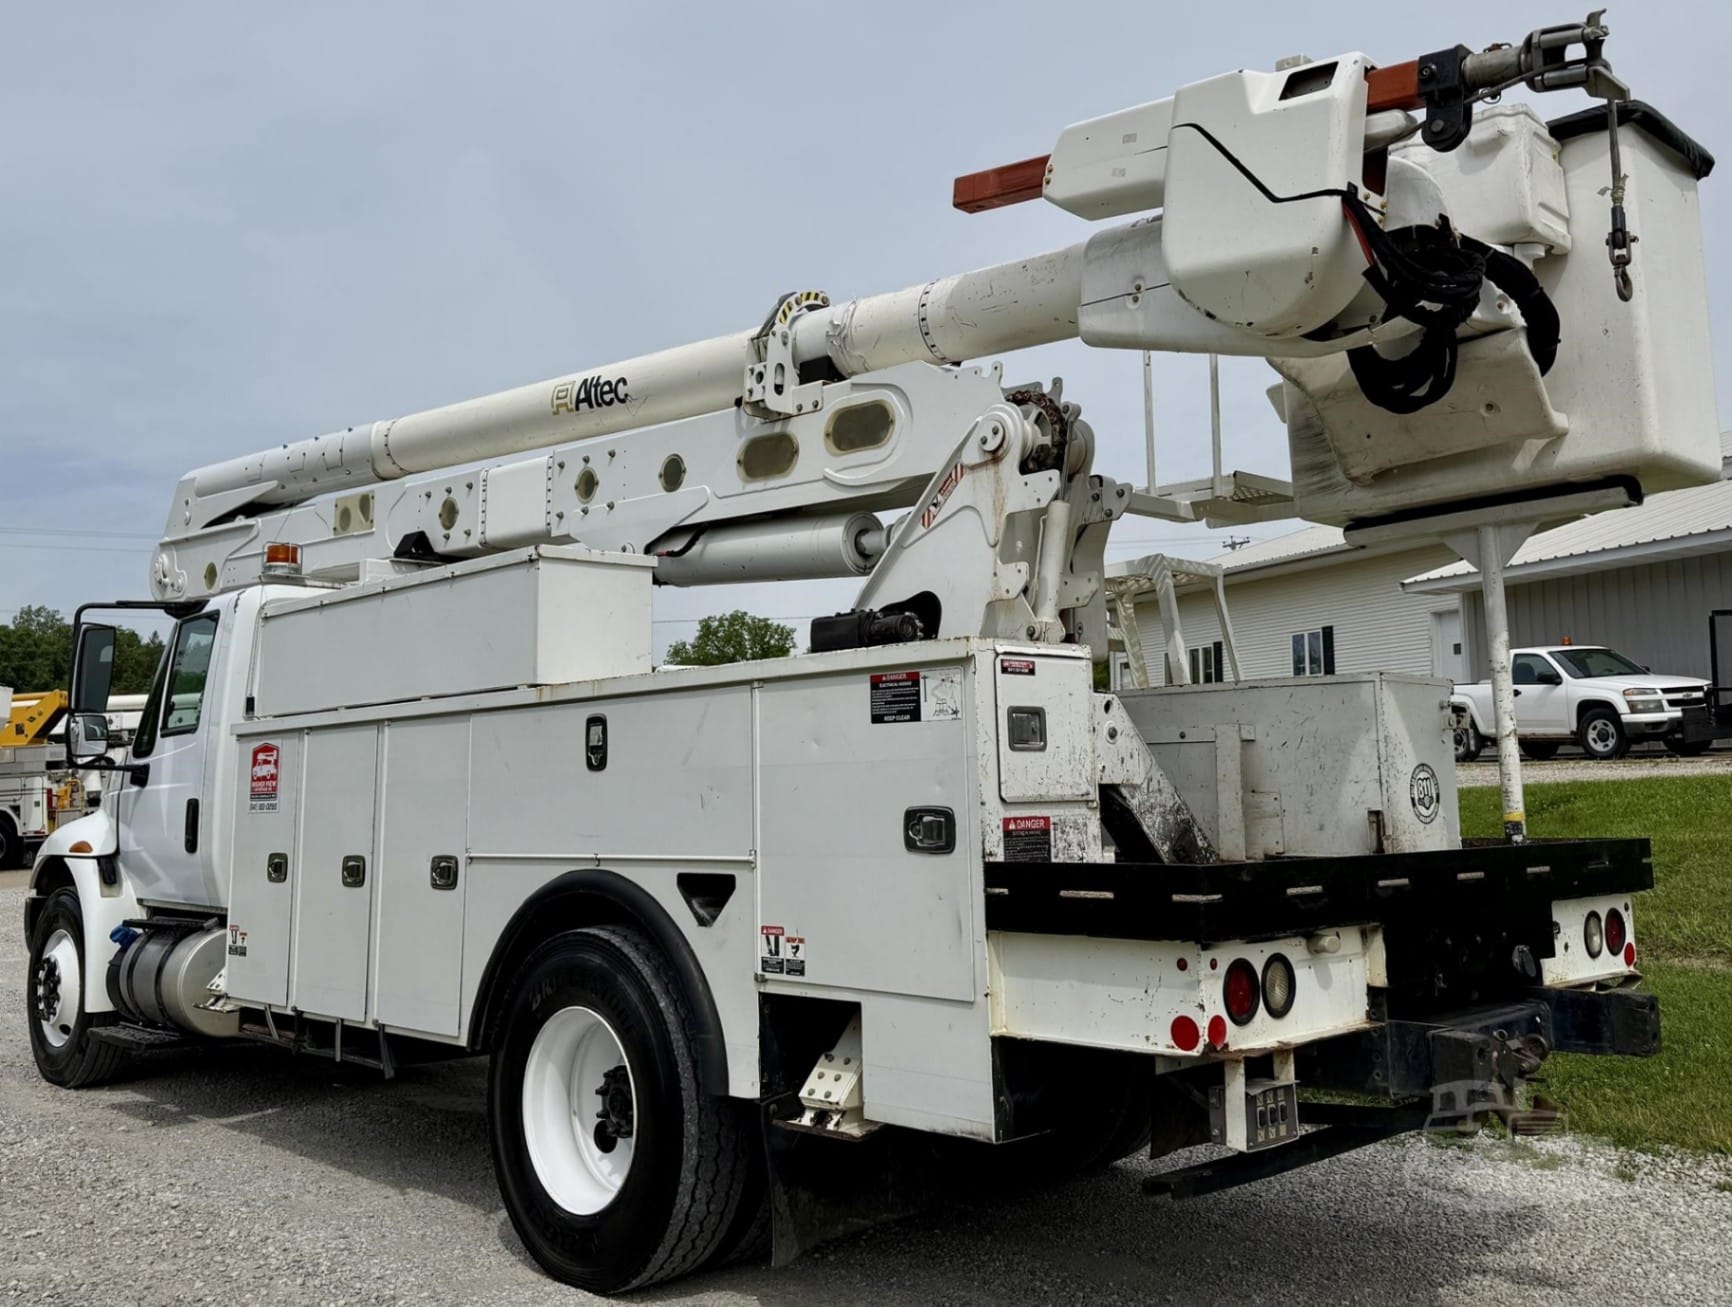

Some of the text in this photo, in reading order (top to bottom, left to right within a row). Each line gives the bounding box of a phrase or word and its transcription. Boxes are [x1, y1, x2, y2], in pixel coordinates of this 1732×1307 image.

[575, 375, 628, 411] Altec
[1418, 778, 1432, 799] 811
[1016, 818, 1045, 829] DANGER
